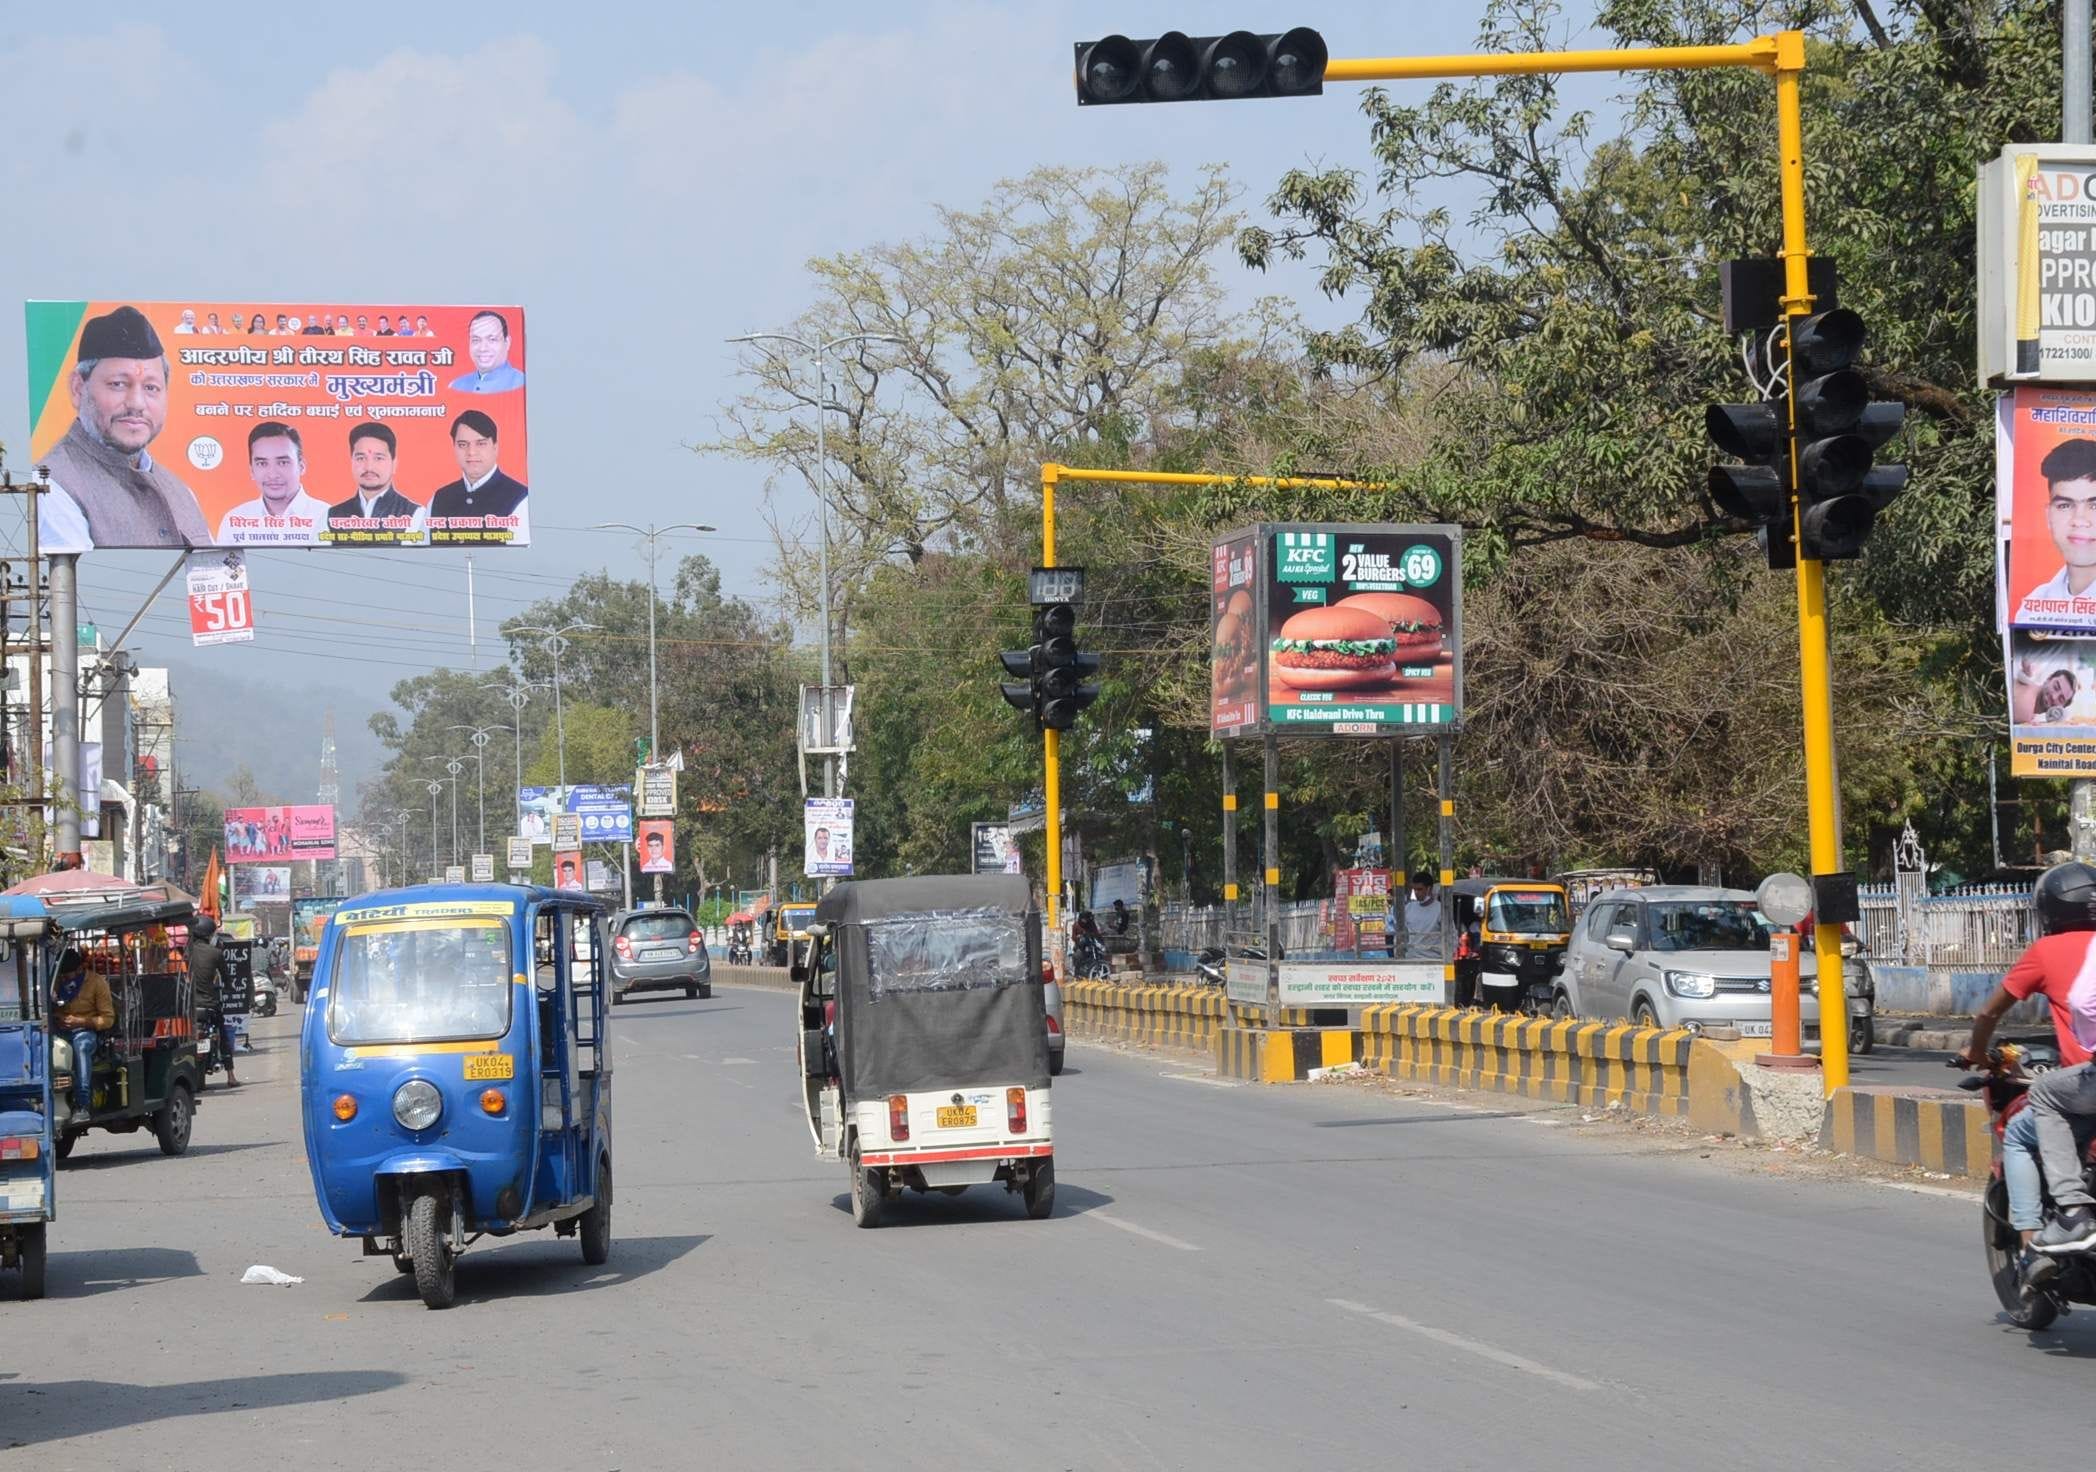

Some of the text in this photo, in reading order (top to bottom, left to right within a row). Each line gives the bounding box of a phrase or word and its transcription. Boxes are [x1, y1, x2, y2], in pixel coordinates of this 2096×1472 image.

[179, 344, 454, 367] आदरणीय श्री तीरथ सिंह रावत जी
[190, 370, 206, 386] को
[266, 374, 306, 387] सरकार
[326, 369, 437, 401] मुख्यमंत्री
[195, 402, 229, 417] बनने
[233, 405, 254, 416] पर
[258, 402, 302, 417] हार्दिक
[345, 403, 363, 417] एवं
[1287, 549, 1325, 562] KFC
[1342, 554, 1390, 581] 2 VALUE
[1357, 567, 1406, 581] BURGERS
[1302, 590, 1318, 600] VEG
[2024, 599, 2069, 613] यशपाल
[1286, 708, 1385, 720] KFC Haldwani Drive Thru
[2017, 743, 2044, 754] Durga
[2046, 743, 2063, 754] City
[2037, 759, 2073, 770] Nainital
[1744, 1025, 1757, 1034] UK
[471, 1067, 511, 1078] ER0319
